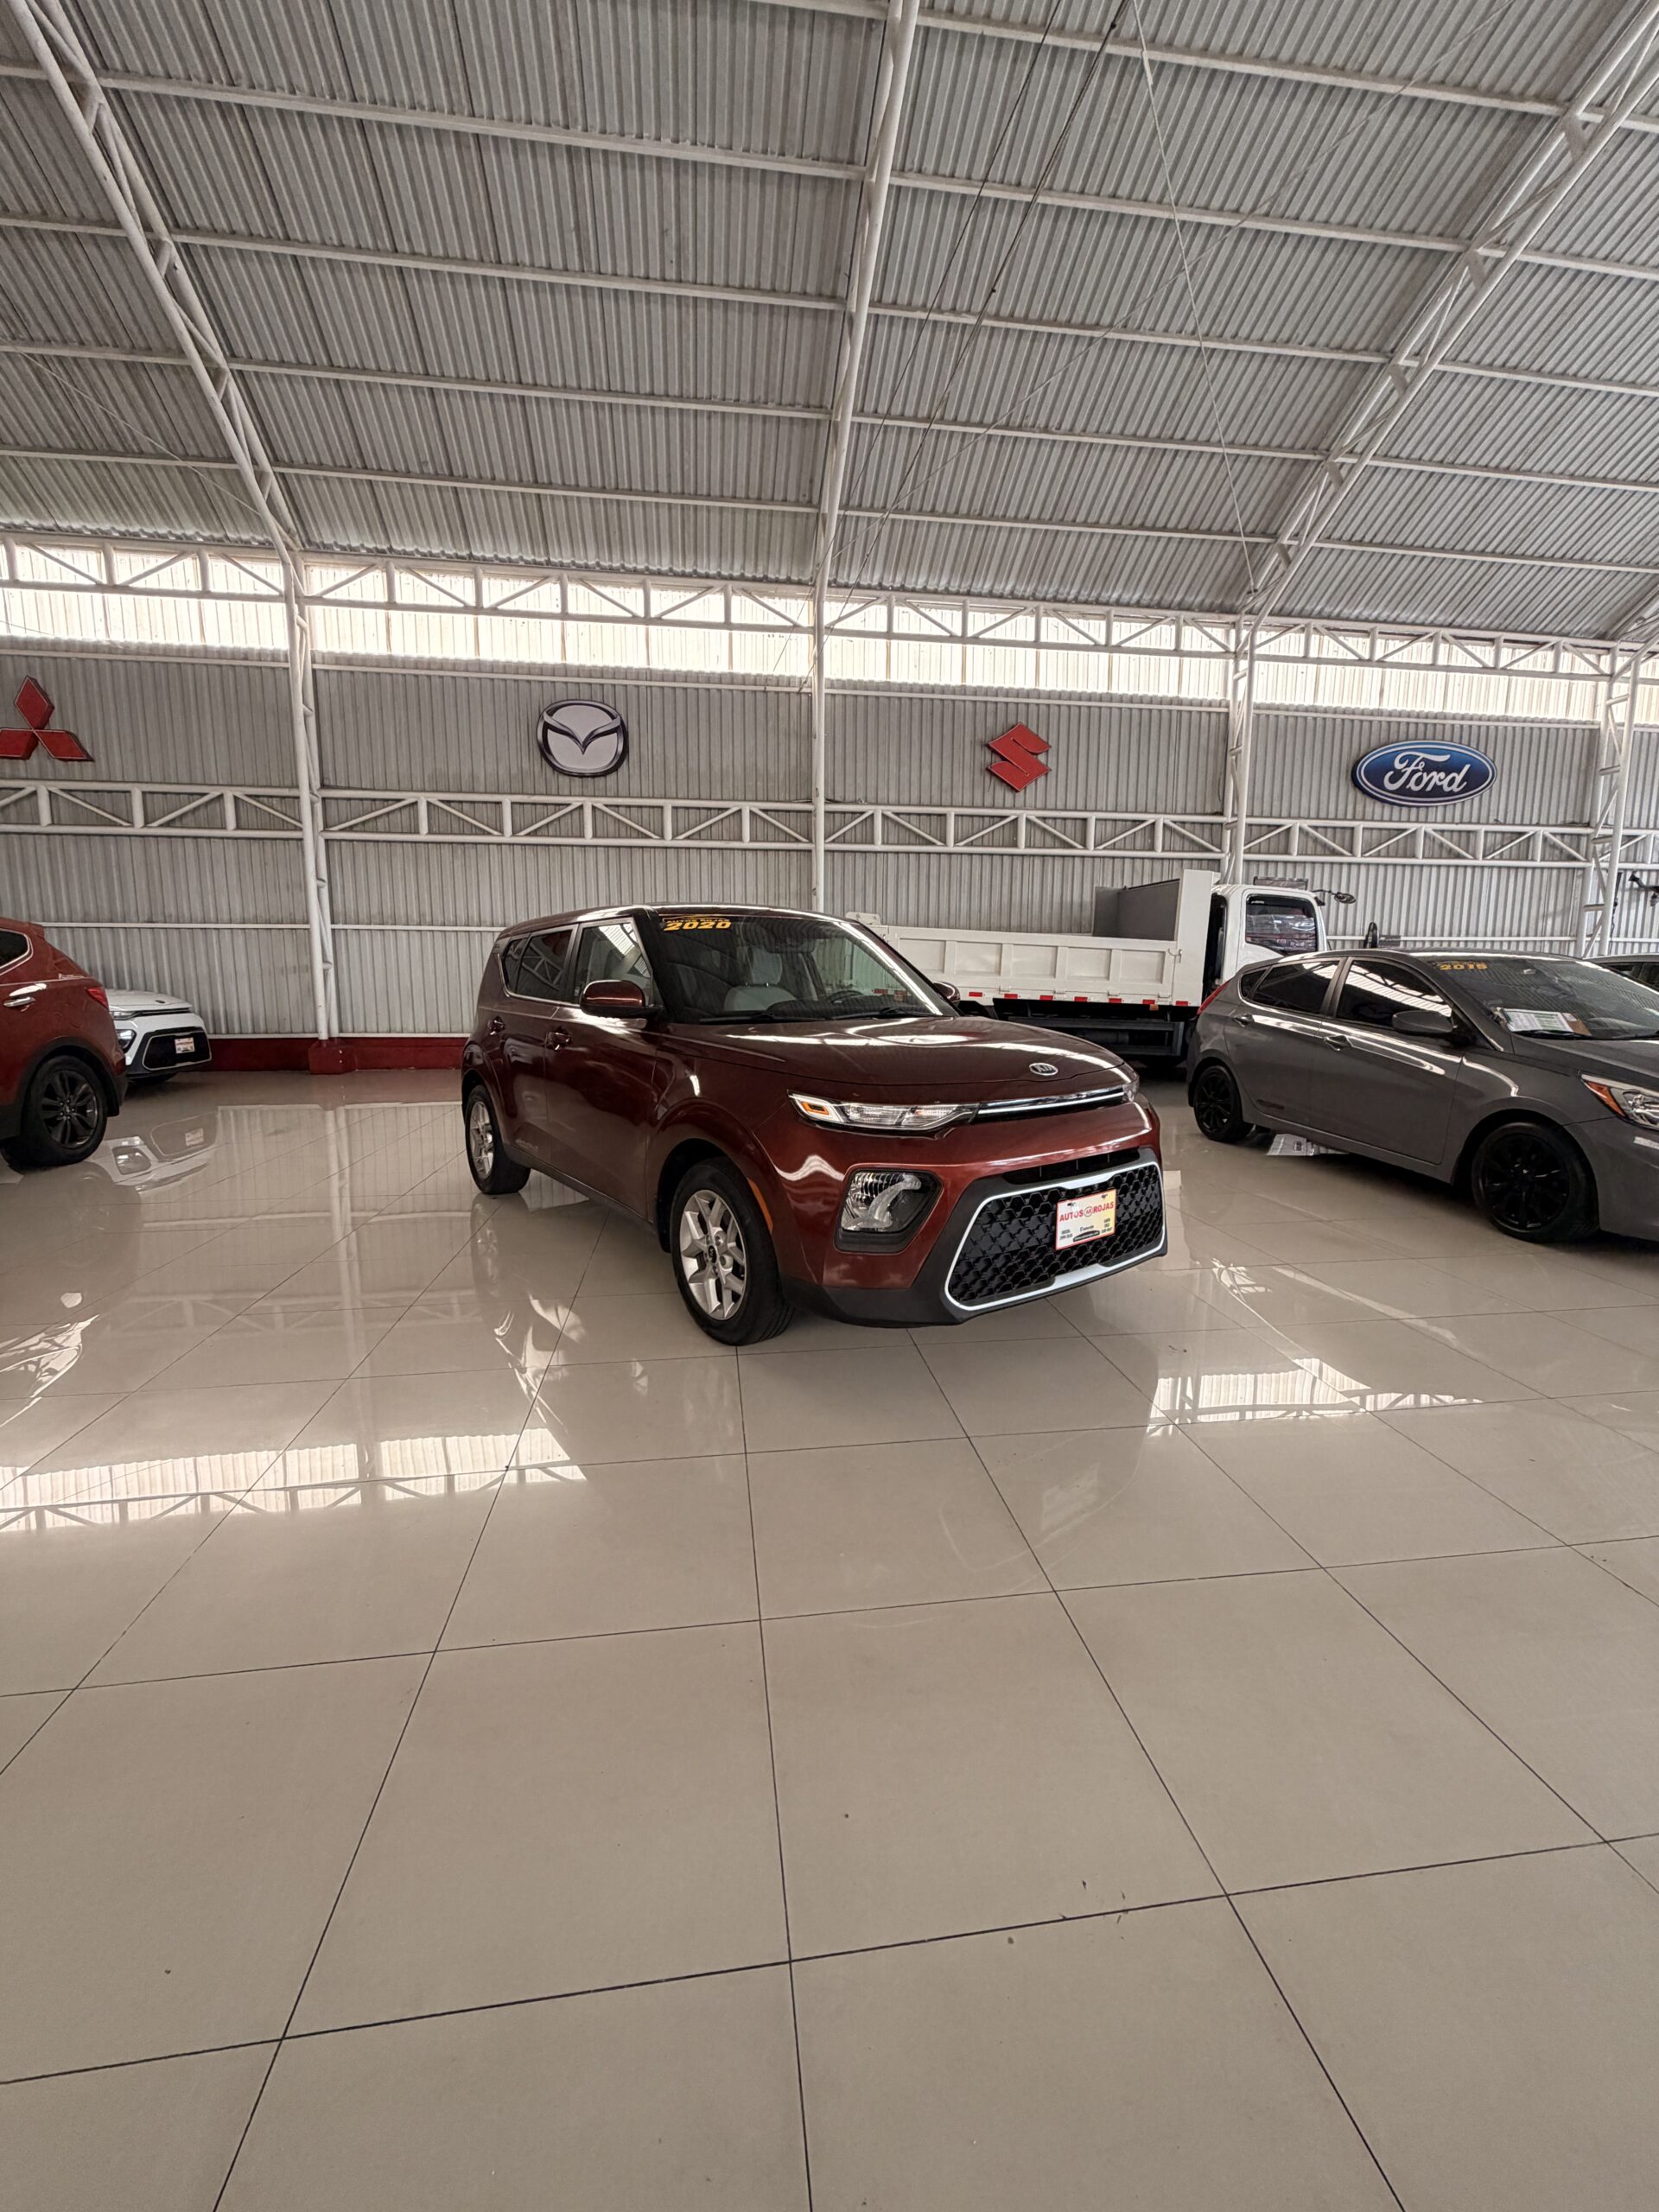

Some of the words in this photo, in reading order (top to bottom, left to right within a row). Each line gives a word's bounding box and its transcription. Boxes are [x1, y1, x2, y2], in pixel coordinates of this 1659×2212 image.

[1383, 751, 1471, 793] Ford
[664, 921, 732, 931] 2020
[1059, 1210, 1084, 1222] AUTOS
[1092, 1202, 1114, 1213] ROJAS
